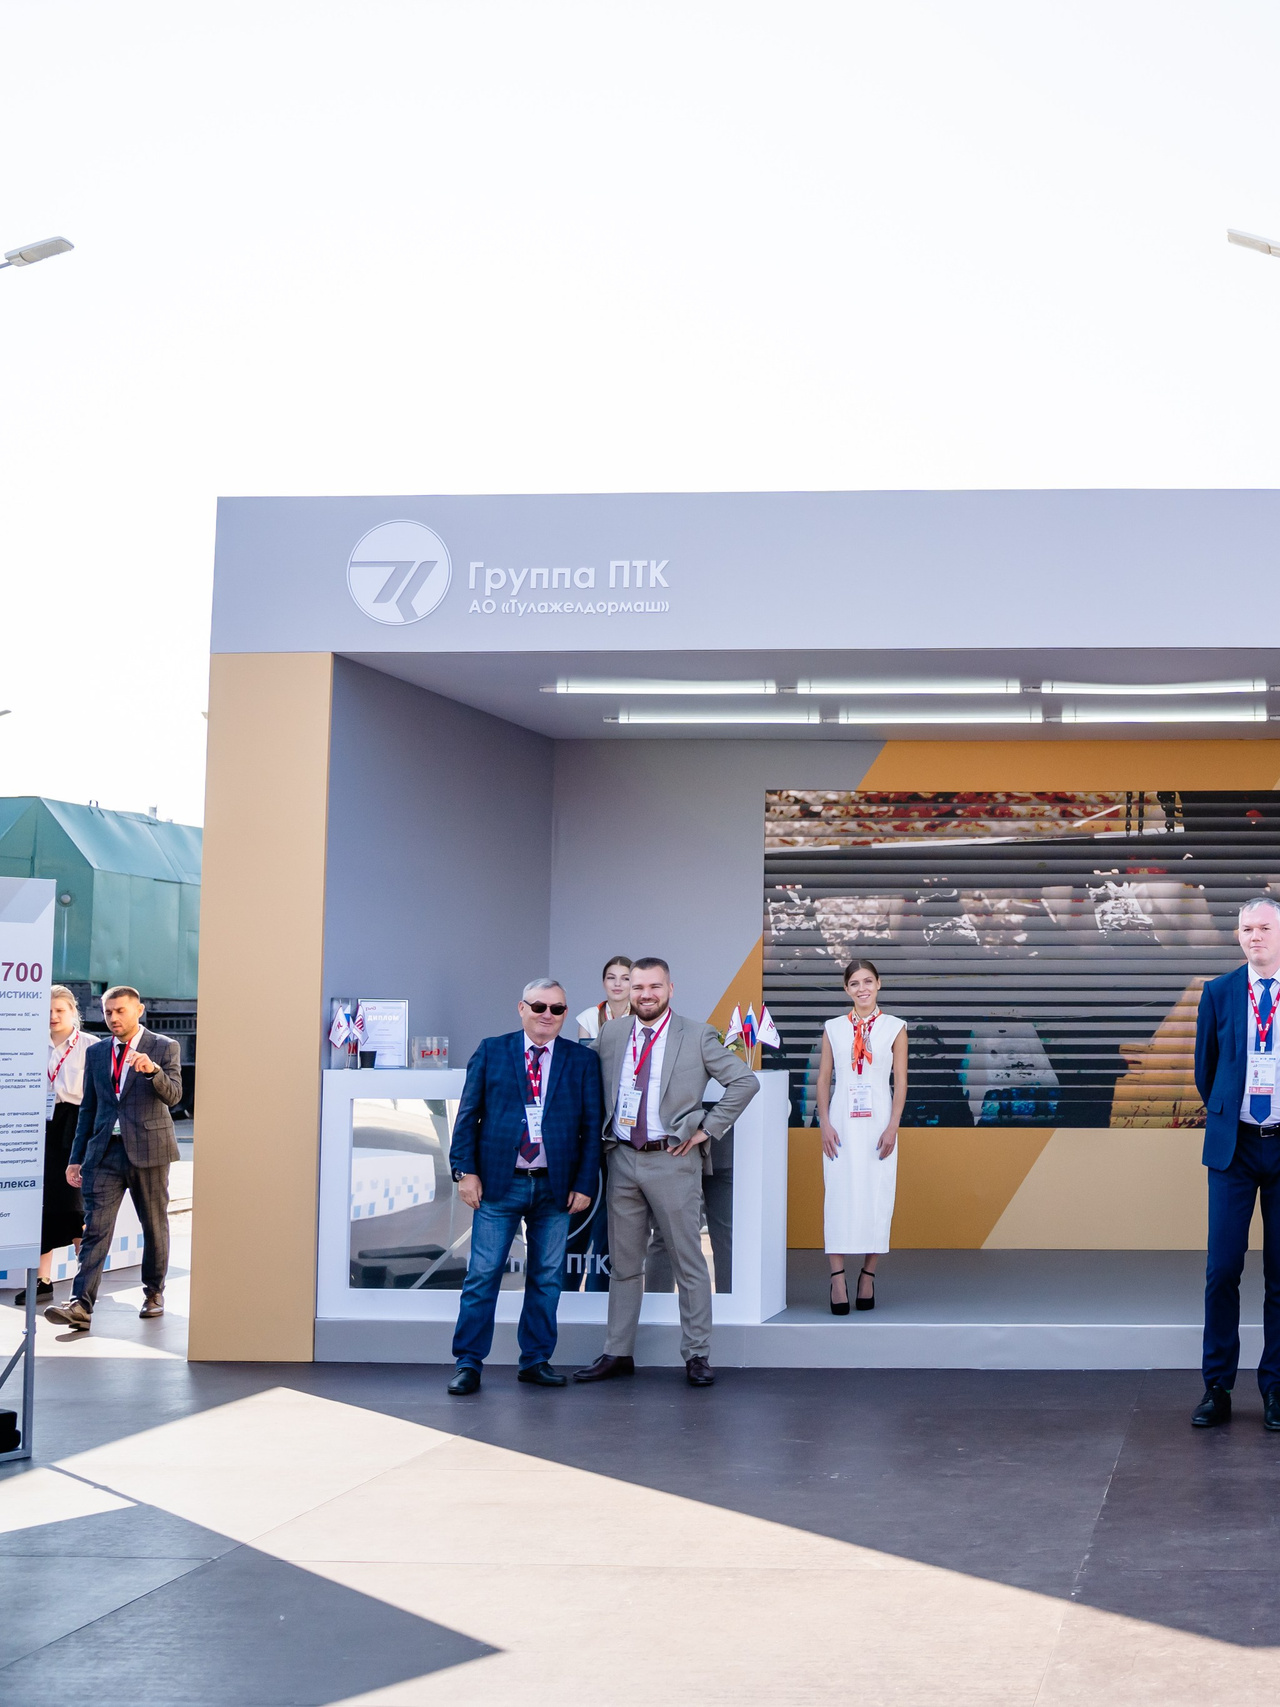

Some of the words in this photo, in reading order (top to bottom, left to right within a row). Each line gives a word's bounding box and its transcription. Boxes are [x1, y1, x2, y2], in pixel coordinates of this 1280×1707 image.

[468, 561, 596, 597] Группа
[609, 559, 670, 589] ПТК
[468, 599, 497, 614] АО
[501, 599, 670, 617] «Тулажелдормаш»
[1, 961, 43, 983] 700
[566, 1253, 612, 1275] ПТК
